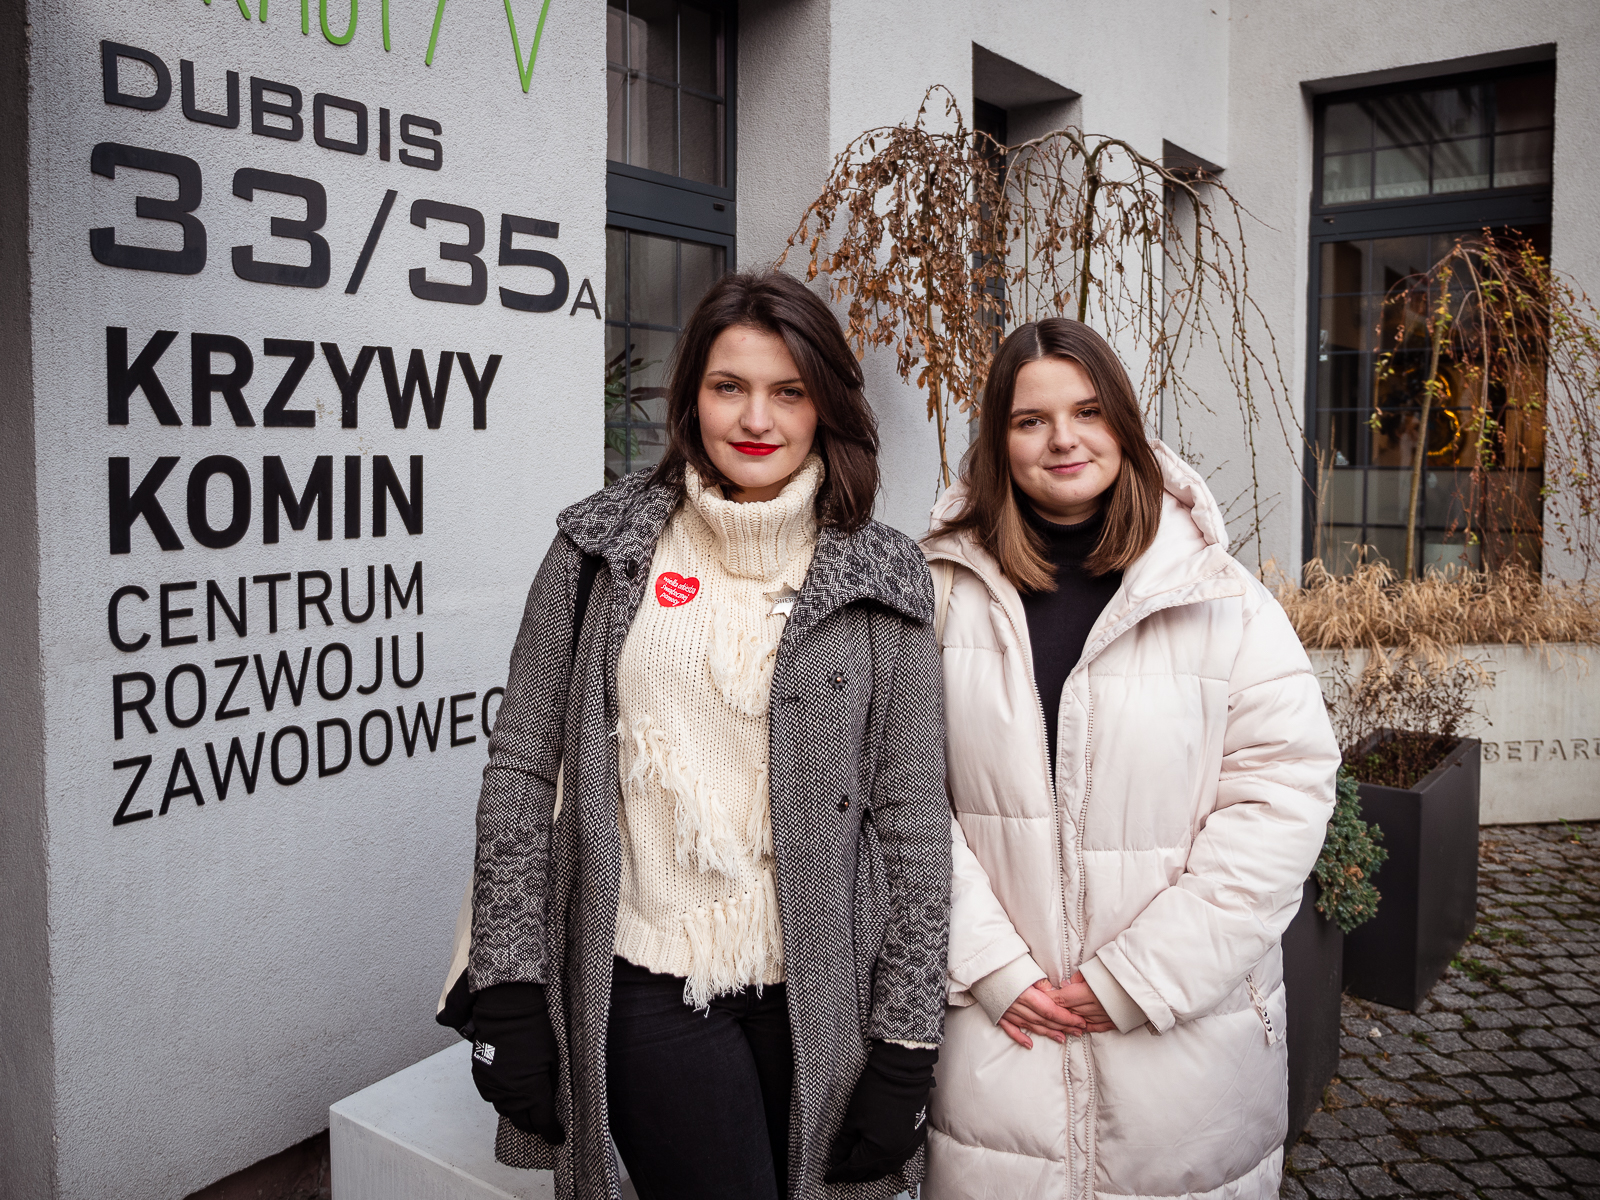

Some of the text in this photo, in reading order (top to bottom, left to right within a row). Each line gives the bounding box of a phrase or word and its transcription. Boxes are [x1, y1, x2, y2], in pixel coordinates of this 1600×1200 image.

[101, 40, 443, 171] DUBOIS
[106, 326, 502, 430] KRZYWY
[108, 454, 424, 555] KOMIN
[108, 561, 424, 653] CENTRUM
[112, 631, 424, 740] ROZWOJU
